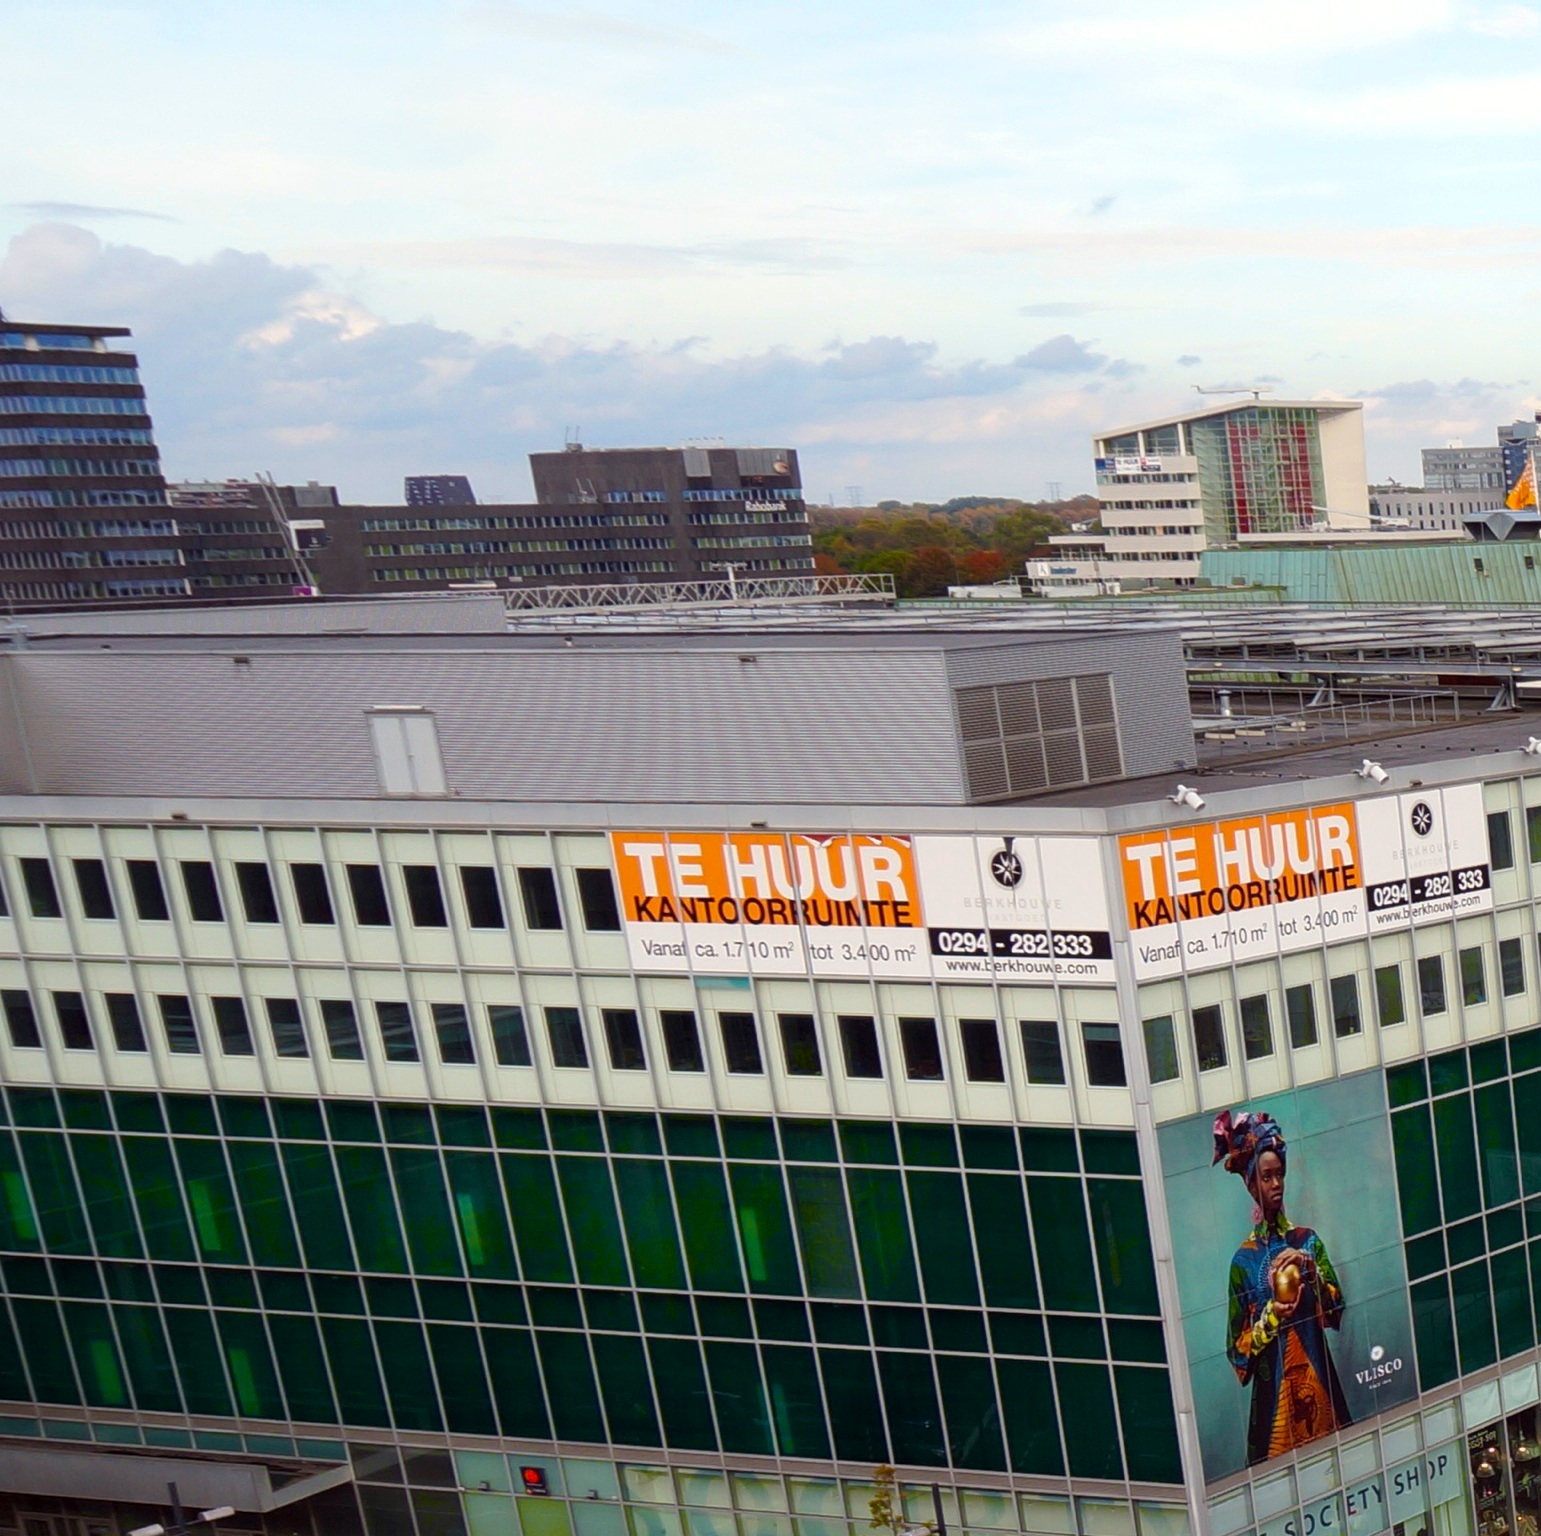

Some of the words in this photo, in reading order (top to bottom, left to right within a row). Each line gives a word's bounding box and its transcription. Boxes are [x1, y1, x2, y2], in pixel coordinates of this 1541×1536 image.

[622, 843, 710, 899] TE
[726, 843, 909, 901] HUUR
[1126, 838, 1200, 901] TE
[1213, 815, 1355, 887] HUUR
[1135, 864, 1358, 929] KANTOORRUIMTE
[1373, 883, 1409, 907] 0294
[1424, 875, 1451, 897] 282
[1457, 869, 1484, 891] 333
[634, 896, 913, 928] KANTOORRUIMTE
[641, 939, 687, 958] Vanaf
[695, 945, 719, 958] ca.
[723, 941, 770, 958] 1.710
[811, 945, 834, 960] tot
[842, 943, 890, 962] 3.400
[938, 932, 989, 954] 0294
[1010, 933, 1049, 956] 282
[1053, 935, 1094, 956] 333
[1188, 939, 1208, 954] ca.
[1212, 928, 1248, 951] 1.710
[1279, 920, 1298, 937] tot
[1303, 911, 1339, 933] 3.400
[1355, 1358, 1402, 1384] VLISCO
[1394, 1455, 1447, 1495] SHOP
